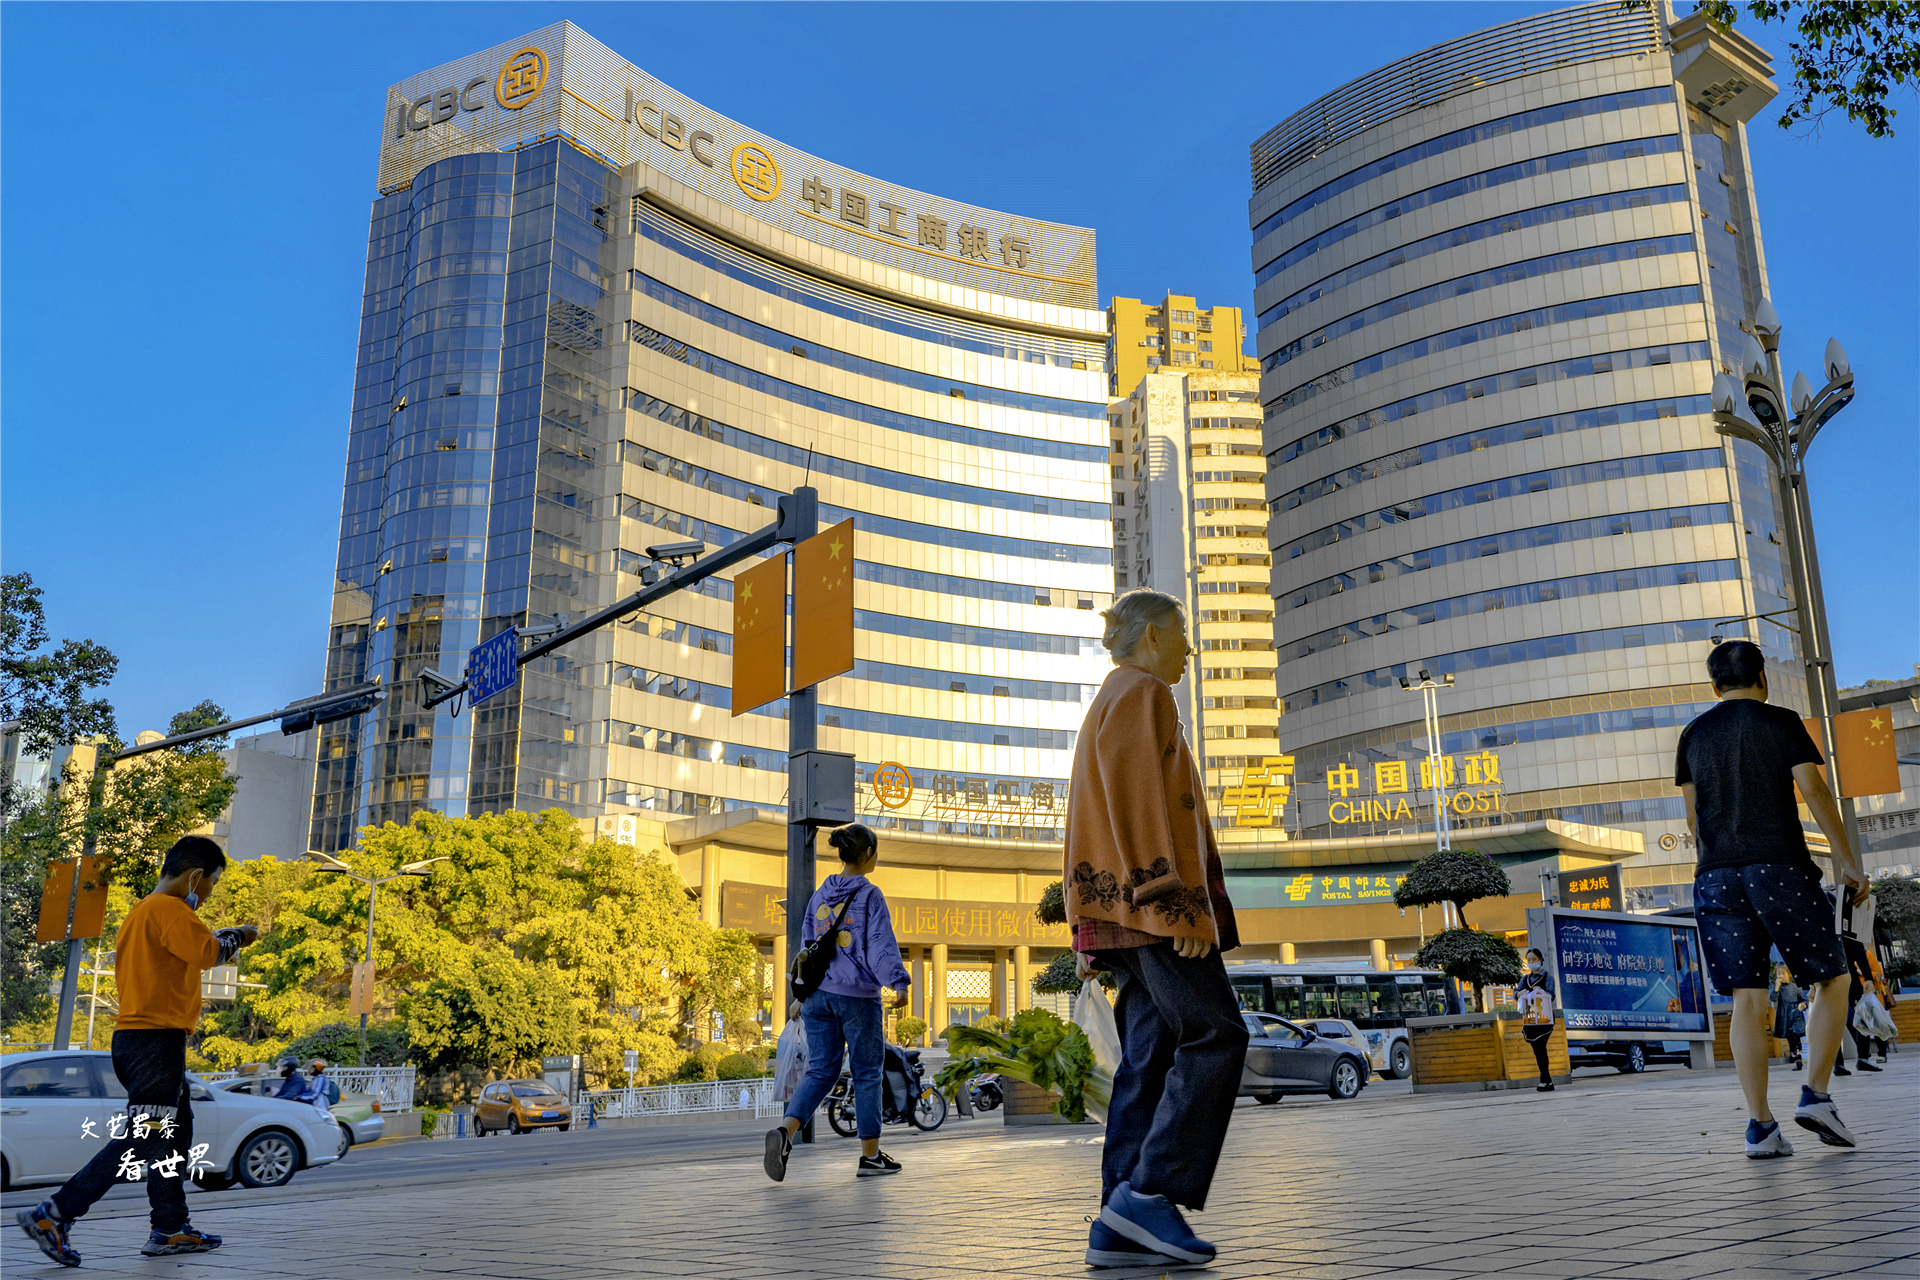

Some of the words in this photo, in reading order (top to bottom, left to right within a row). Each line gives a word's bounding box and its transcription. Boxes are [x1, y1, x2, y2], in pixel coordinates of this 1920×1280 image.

[397, 75, 487, 138] ICBC
[625, 88, 714, 168] ICBC
[802, 176, 1031, 268] 中国工商银行
[934, 774, 1055, 809] 中国工商
[1327, 750, 1502, 798] 中国邮政
[1328, 797, 1413, 824] CHINA
[1437, 788, 1502, 817] POST
[1322, 891, 1352, 900] POSTAL
[1358, 889, 1391, 898] SAVINGS
[1569, 876, 1609, 893] 忠诚为民
[1563, 950, 1613, 970] 问学天地宽
[1574, 1014, 1593, 1026] 3555
[1594, 1014, 1608, 1027] 999
